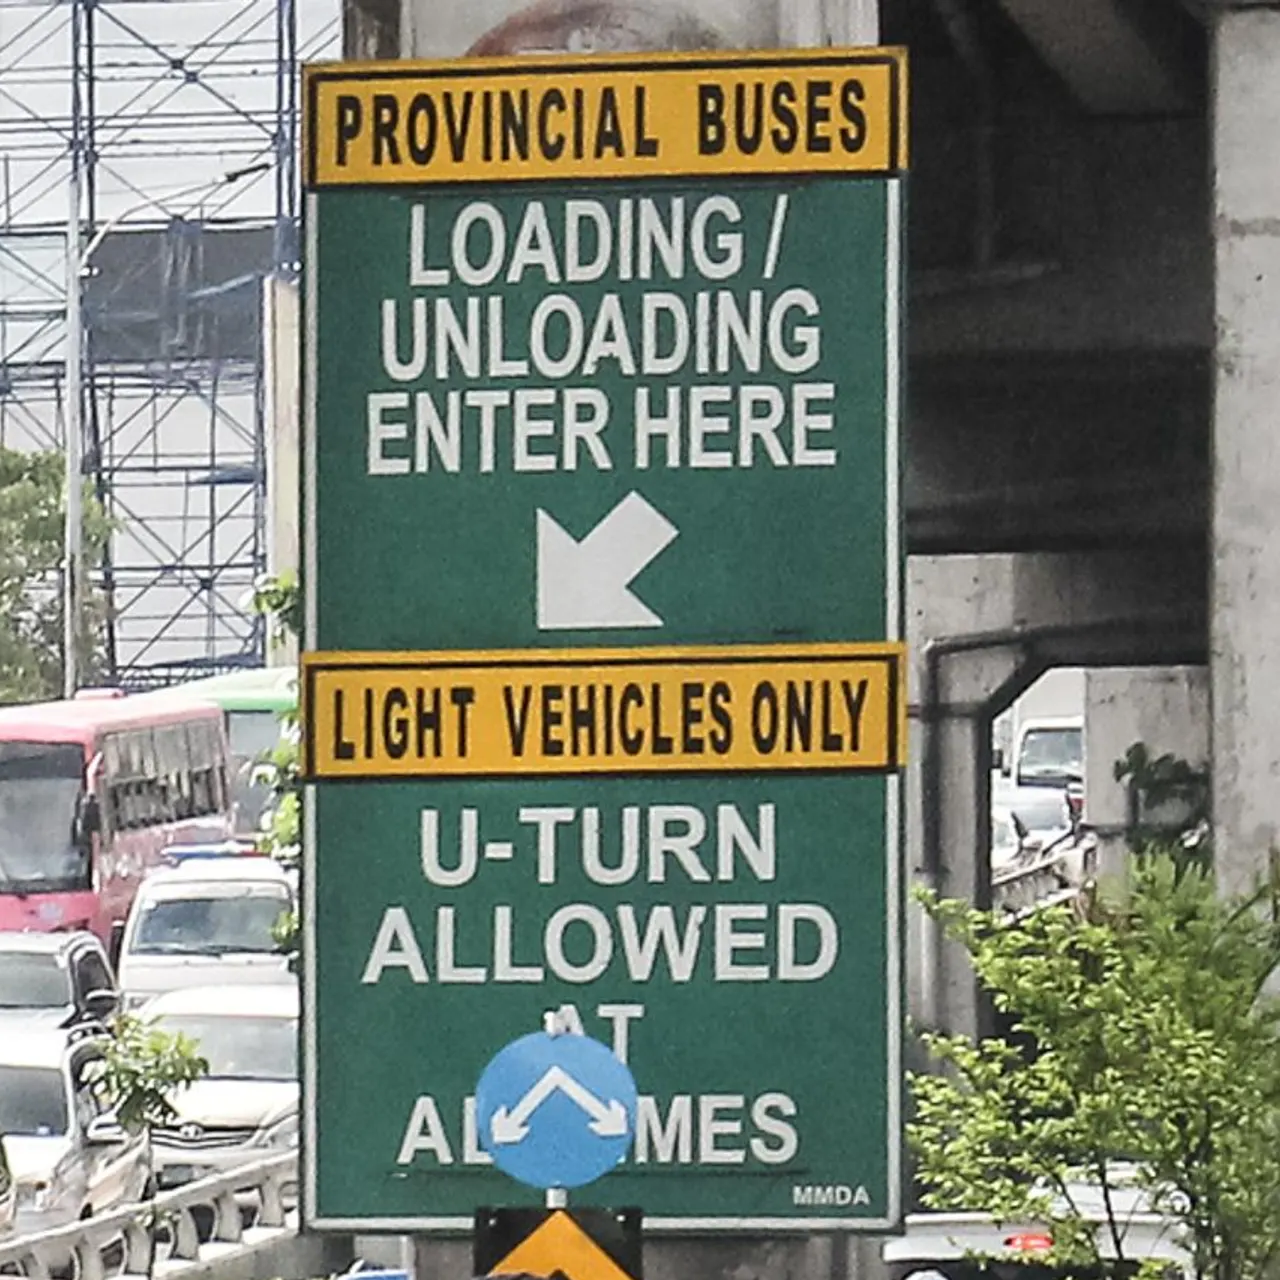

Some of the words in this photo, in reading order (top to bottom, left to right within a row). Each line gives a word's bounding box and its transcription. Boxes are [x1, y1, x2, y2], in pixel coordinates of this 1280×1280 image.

[335, 85, 658, 166] PROVINCIAL
[698, 79, 867, 156] BUSES
[381, 289, 820, 381] UNLOADING
[366, 389, 612, 477] ENTER
[635, 383, 836, 470] HERE
[333, 686, 475, 761] LIGHT
[504, 681, 733, 759] VEHICLES
[751, 678, 869, 754] ONLY
[419, 803, 776, 887] U-TURN
[361, 902, 838, 985] ALLOWED
[792, 1185, 870, 1207] MMDA
